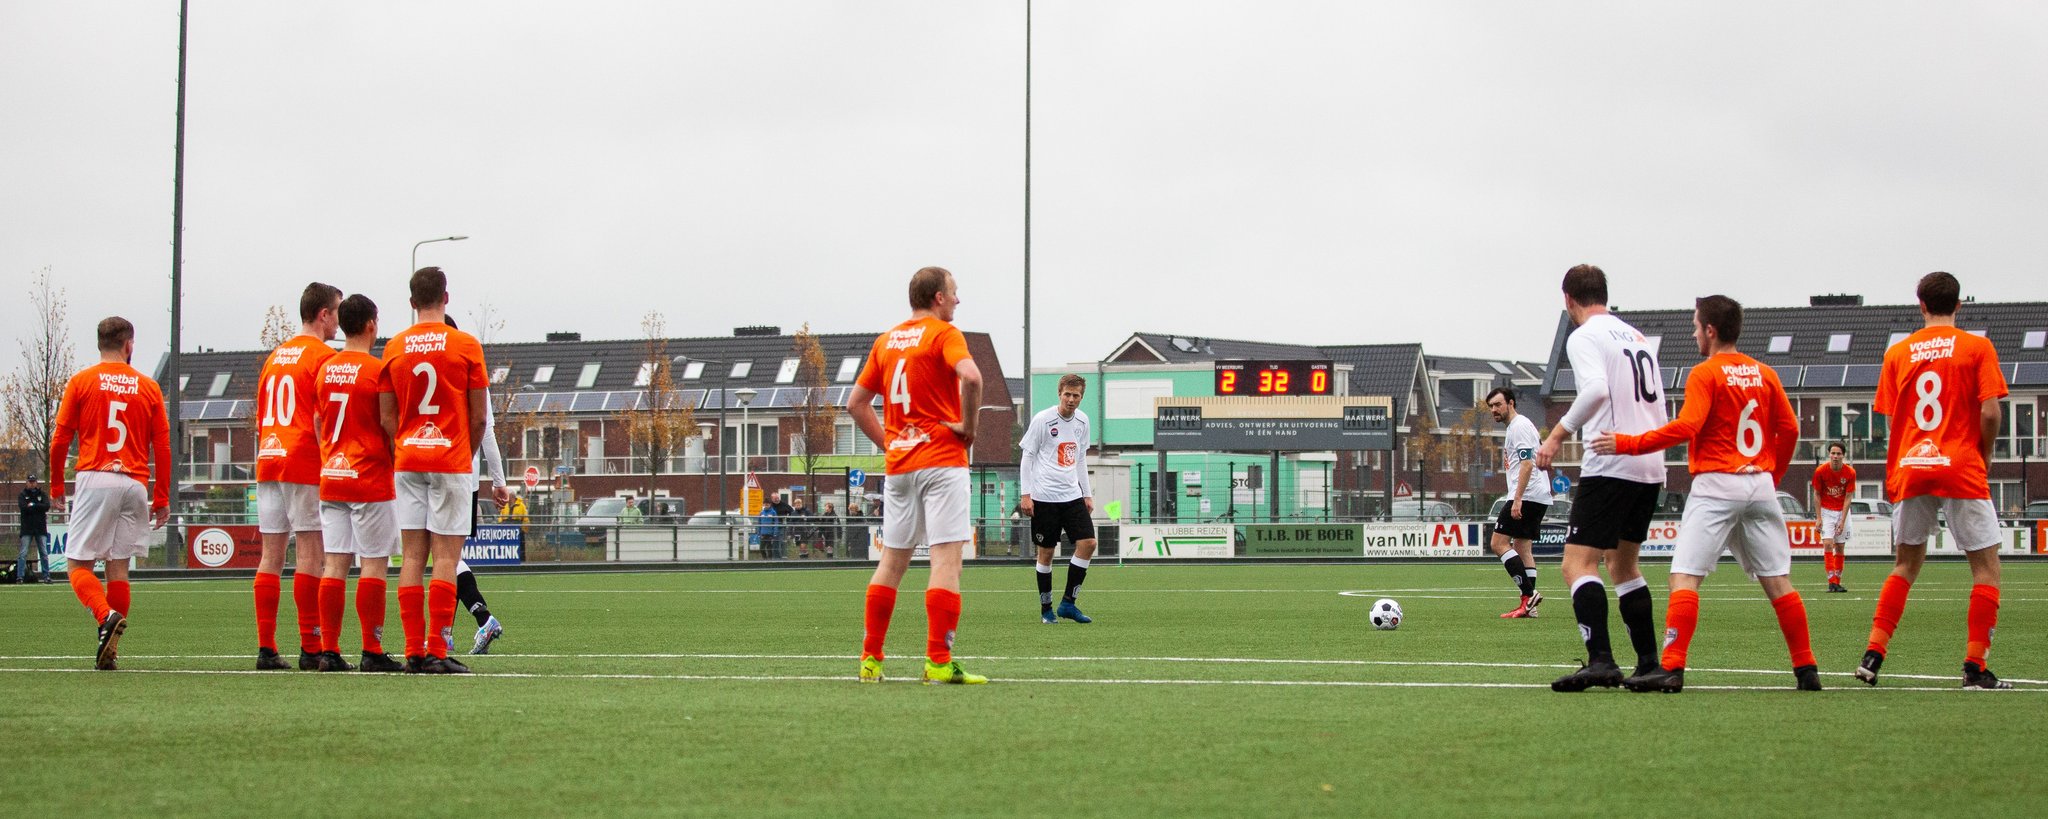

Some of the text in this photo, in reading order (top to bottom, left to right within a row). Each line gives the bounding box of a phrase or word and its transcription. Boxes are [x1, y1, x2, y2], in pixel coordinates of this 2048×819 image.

[405, 332, 448, 344] voetbal
[1609, 329, 1634, 342] ING
[405, 341, 446, 354] shop.nl
[1909, 335, 1956, 352] voetbal
[276, 346, 307, 357] voetbal
[1910, 346, 1953, 362] shop.nl
[272, 355, 300, 366] shop.nl
[326, 363, 362, 374] voetbal
[1722, 364, 1761, 376] voetbal
[99, 373, 139, 385] voetbal
[325, 373, 358, 386] shop.nl
[1221, 372, 1236, 392] 2
[1259, 371, 1289, 392] 32
[1312, 371, 1326, 392] 0
[1623, 349, 1658, 403] 10
[1727, 374, 1763, 391] shop.nl
[100, 381, 138, 395] shop.nl
[412, 362, 440, 415] 2
[890, 358, 911, 415] 4
[262, 375, 296, 427] 10
[1915, 371, 1943, 431] 8
[329, 392, 350, 444] 7
[106, 400, 128, 452] 5
[1736, 399, 1763, 457] 6
[1520, 450, 1529, 460] C
[1197, 527, 1228, 535] REIZEN
[1256, 529, 1354, 541] T.I.B. DE BOER
[1366, 524, 1427, 532] Aannemingsbedrijf
[1367, 533, 1427, 547] van Mil
[462, 545, 519, 560] MARKTLINK
